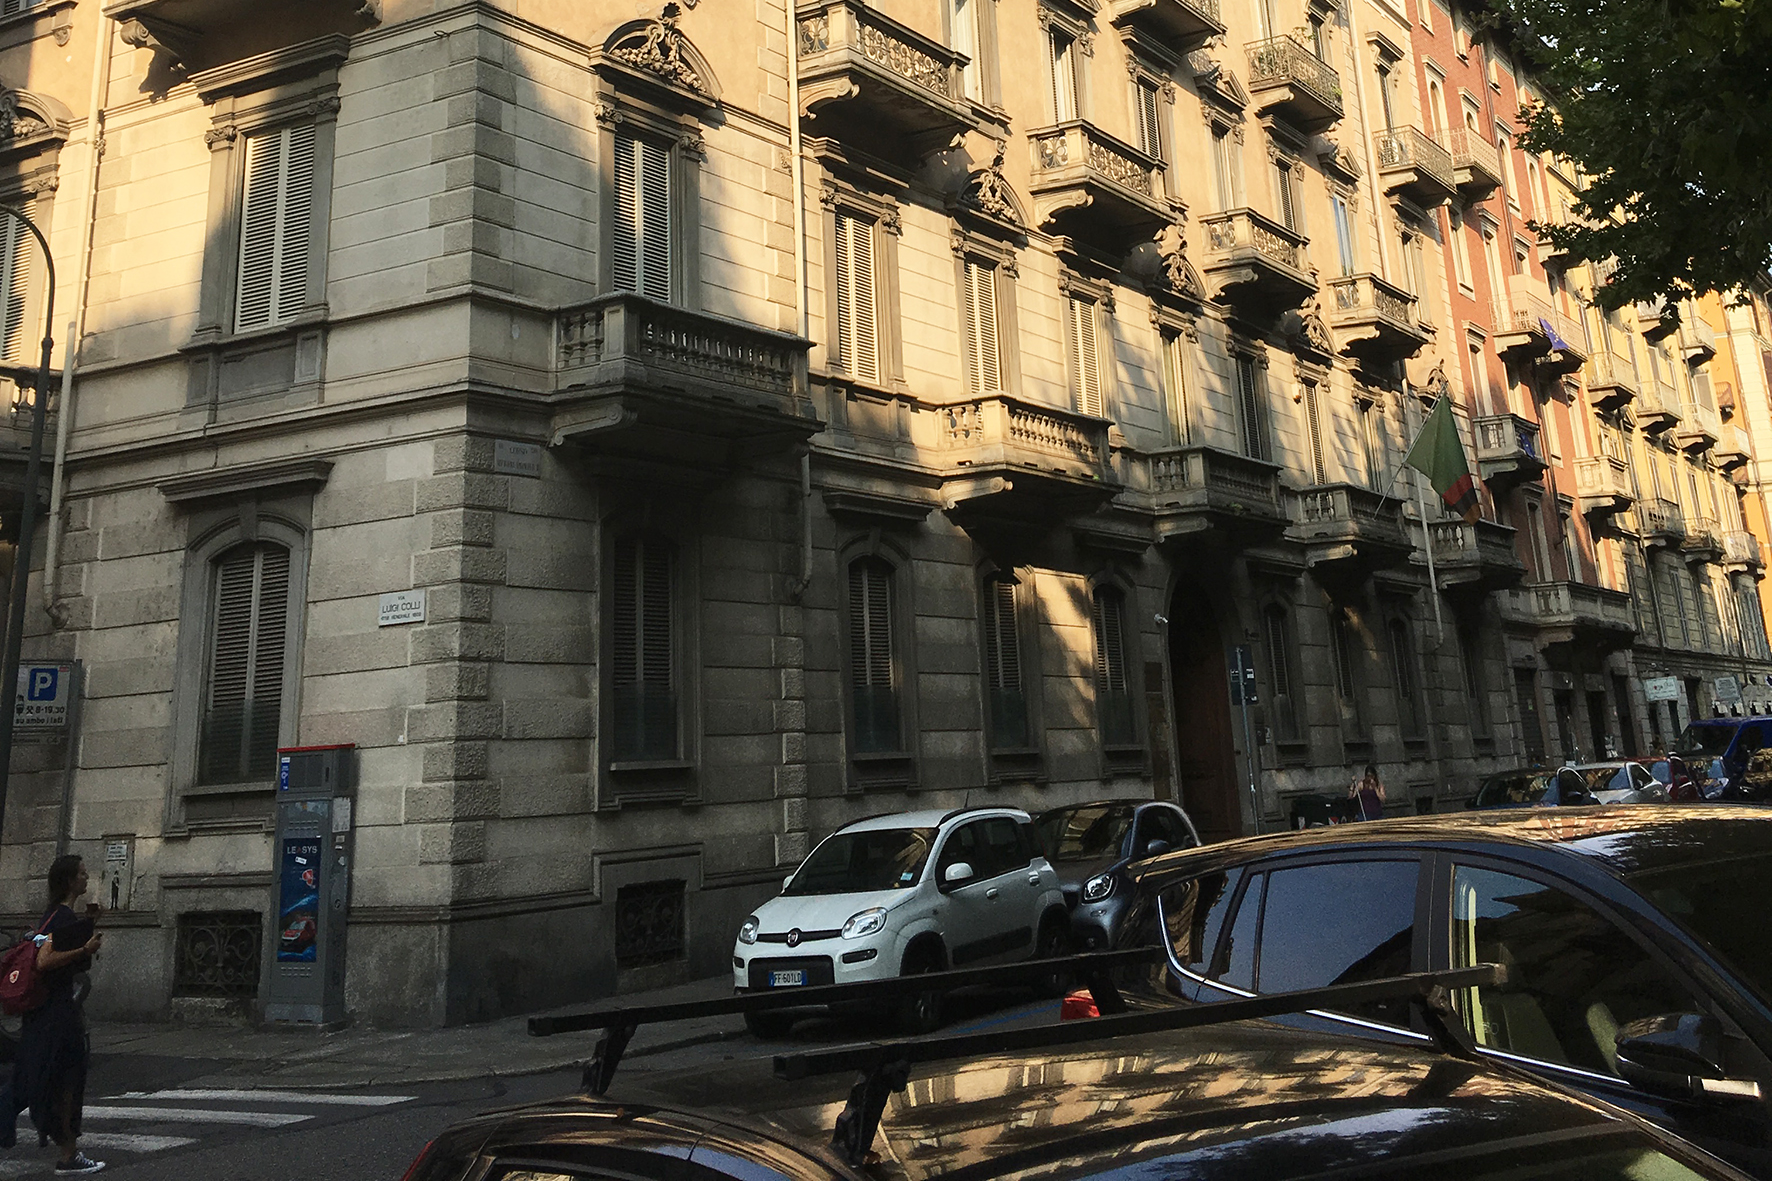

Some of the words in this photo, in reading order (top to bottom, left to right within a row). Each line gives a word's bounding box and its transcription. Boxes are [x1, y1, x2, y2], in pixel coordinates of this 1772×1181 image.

[382, 604, 399, 613] LUIGI
[401, 601, 421, 611] COLLI
[34, 672, 53, 697] P
[50, 716, 63, 724] lati
[287, 845, 318, 854] LEASYS
